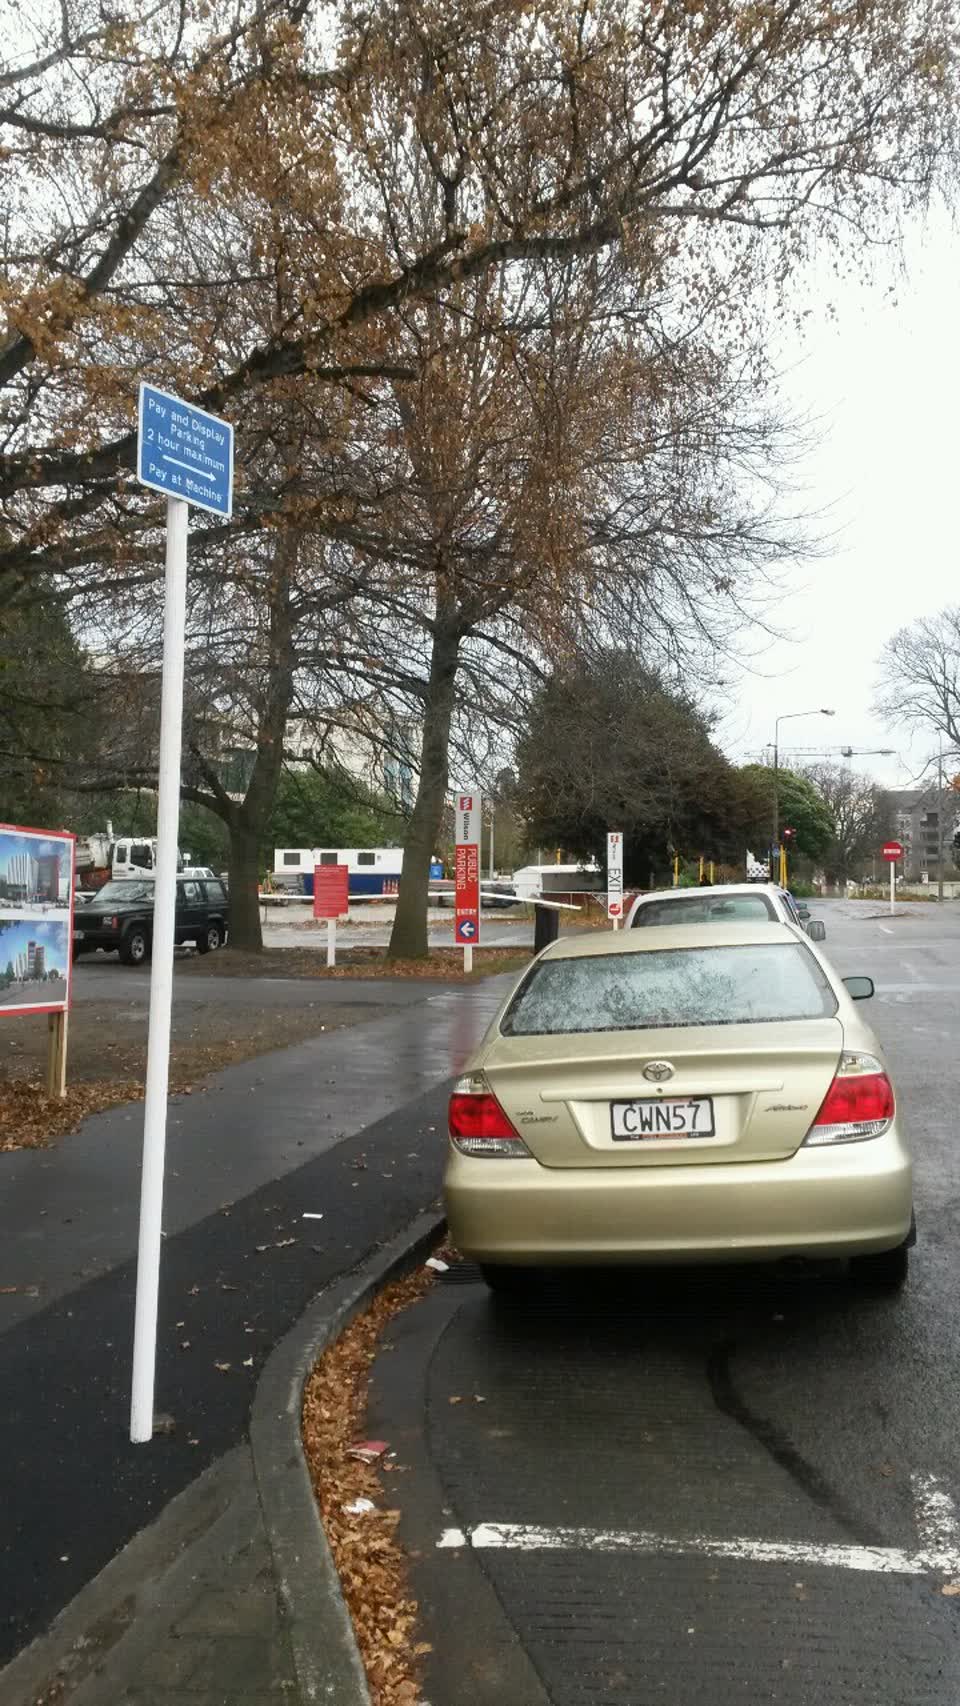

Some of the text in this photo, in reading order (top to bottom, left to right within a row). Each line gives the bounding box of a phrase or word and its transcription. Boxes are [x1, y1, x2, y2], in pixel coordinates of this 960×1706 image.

[148, 398, 225, 446] Pay and Display
[170, 423, 205, 451] Parking
[147, 428, 225, 473] 2 hour maximum
[149, 463, 222, 503] Pay at Machine
[456, 848, 466, 890] PARKING
[468, 848, 478, 883] PUBLIC
[608, 868, 622, 895] EXIT
[623, 1104, 701, 1133] CWN57
